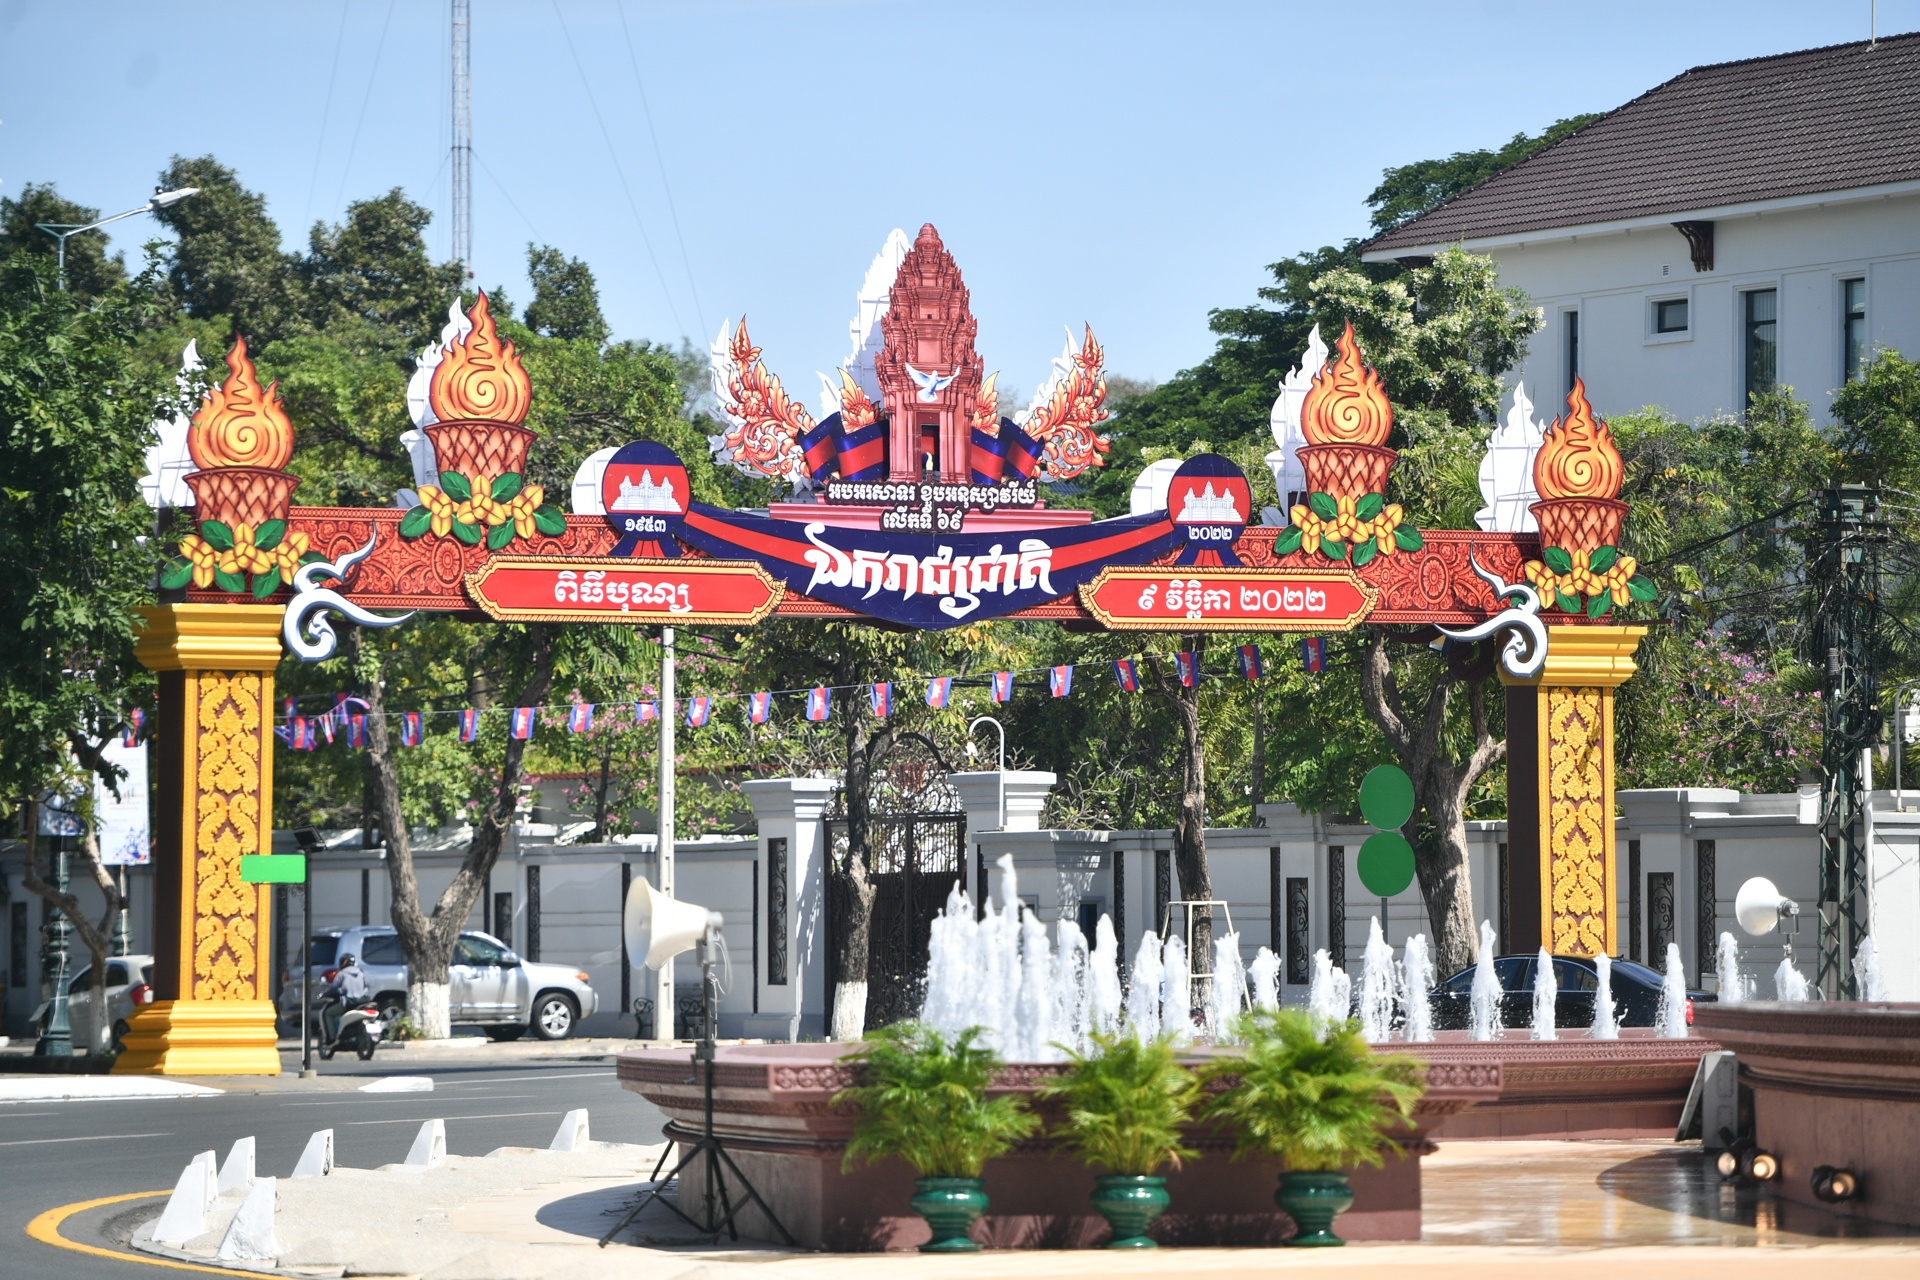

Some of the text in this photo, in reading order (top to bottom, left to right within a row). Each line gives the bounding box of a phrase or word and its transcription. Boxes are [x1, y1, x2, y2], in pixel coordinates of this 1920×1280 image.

[828, 482, 916, 502] អបអរសាទរ
[625, 516, 666, 532] ១៩៥៣
[883, 505, 963, 531] លើកទី ៦៩
[1188, 526, 1232, 540] ២០២២
[804, 522, 1058, 619] ឯករាជ្យជាតិ
[554, 570, 693, 614] ពិធីបុណ្យ
[1138, 579, 1326, 619] ៩ វិច្ឆិកា ២០២២
